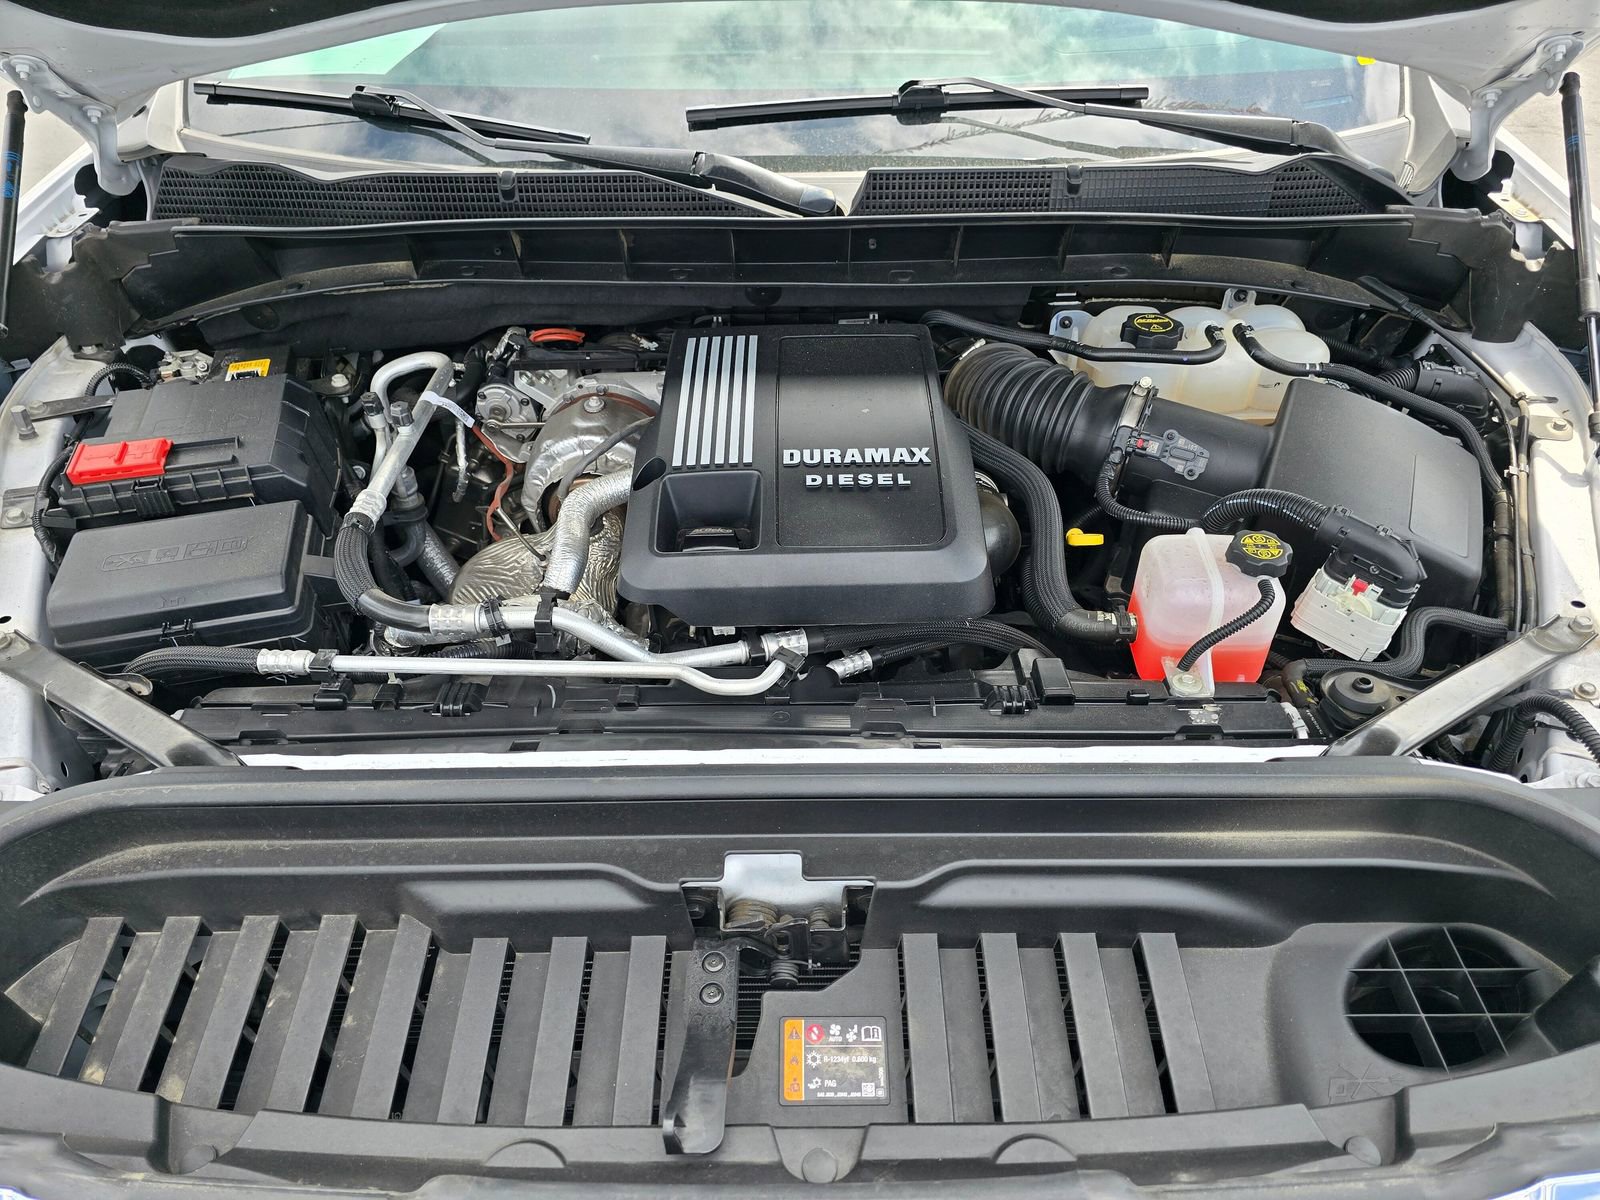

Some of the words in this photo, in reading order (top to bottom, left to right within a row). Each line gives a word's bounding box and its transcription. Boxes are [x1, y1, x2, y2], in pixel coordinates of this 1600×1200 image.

[783, 448, 931, 466] DURAMAX
[805, 473, 912, 488] DIESEL
[824, 1079, 837, 1087] PAG
